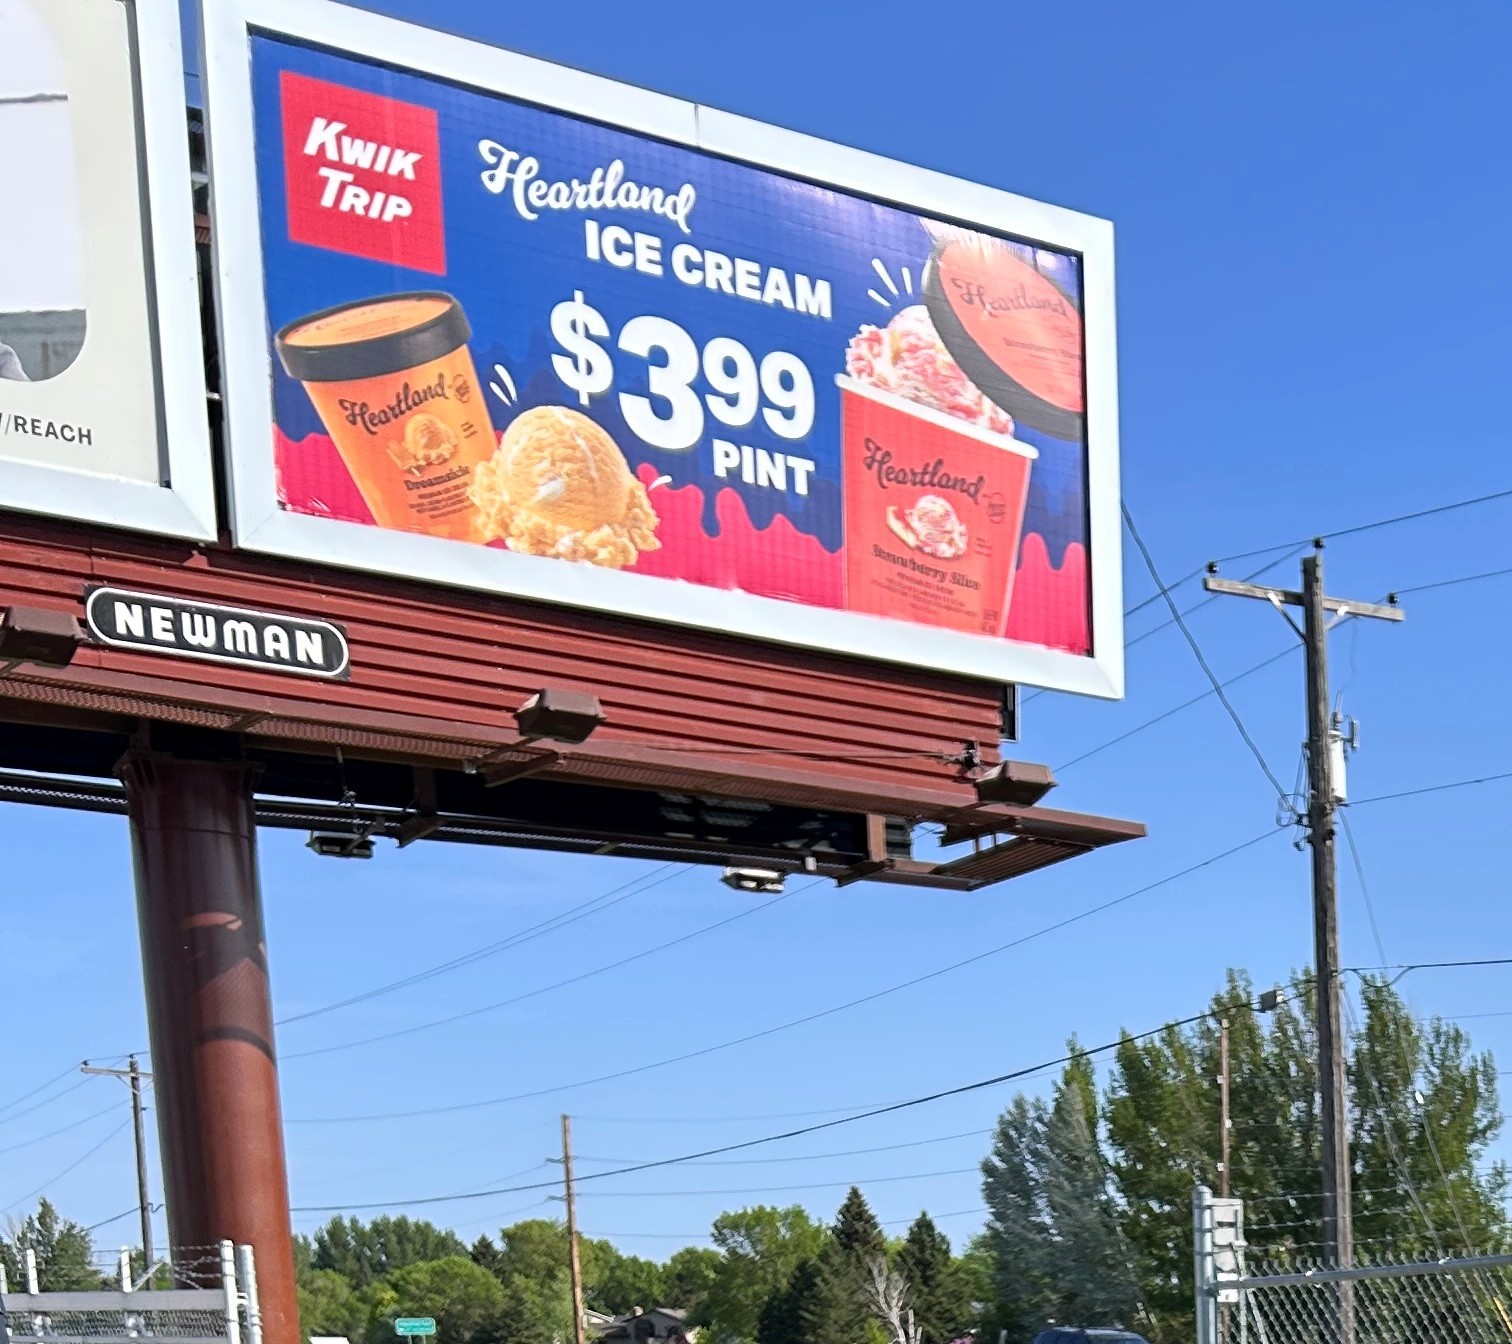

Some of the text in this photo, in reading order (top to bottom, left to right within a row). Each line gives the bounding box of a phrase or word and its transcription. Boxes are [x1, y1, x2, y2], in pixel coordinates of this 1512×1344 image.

[477, 138, 697, 235] Heartland
[584, 219, 833, 320] ICE CREAM
[338, 372, 449, 436] Heartland
[712, 438, 816, 496] PINT
[864, 437, 985, 505] Heartland
[114, 601, 325, 667] NEWMAN
